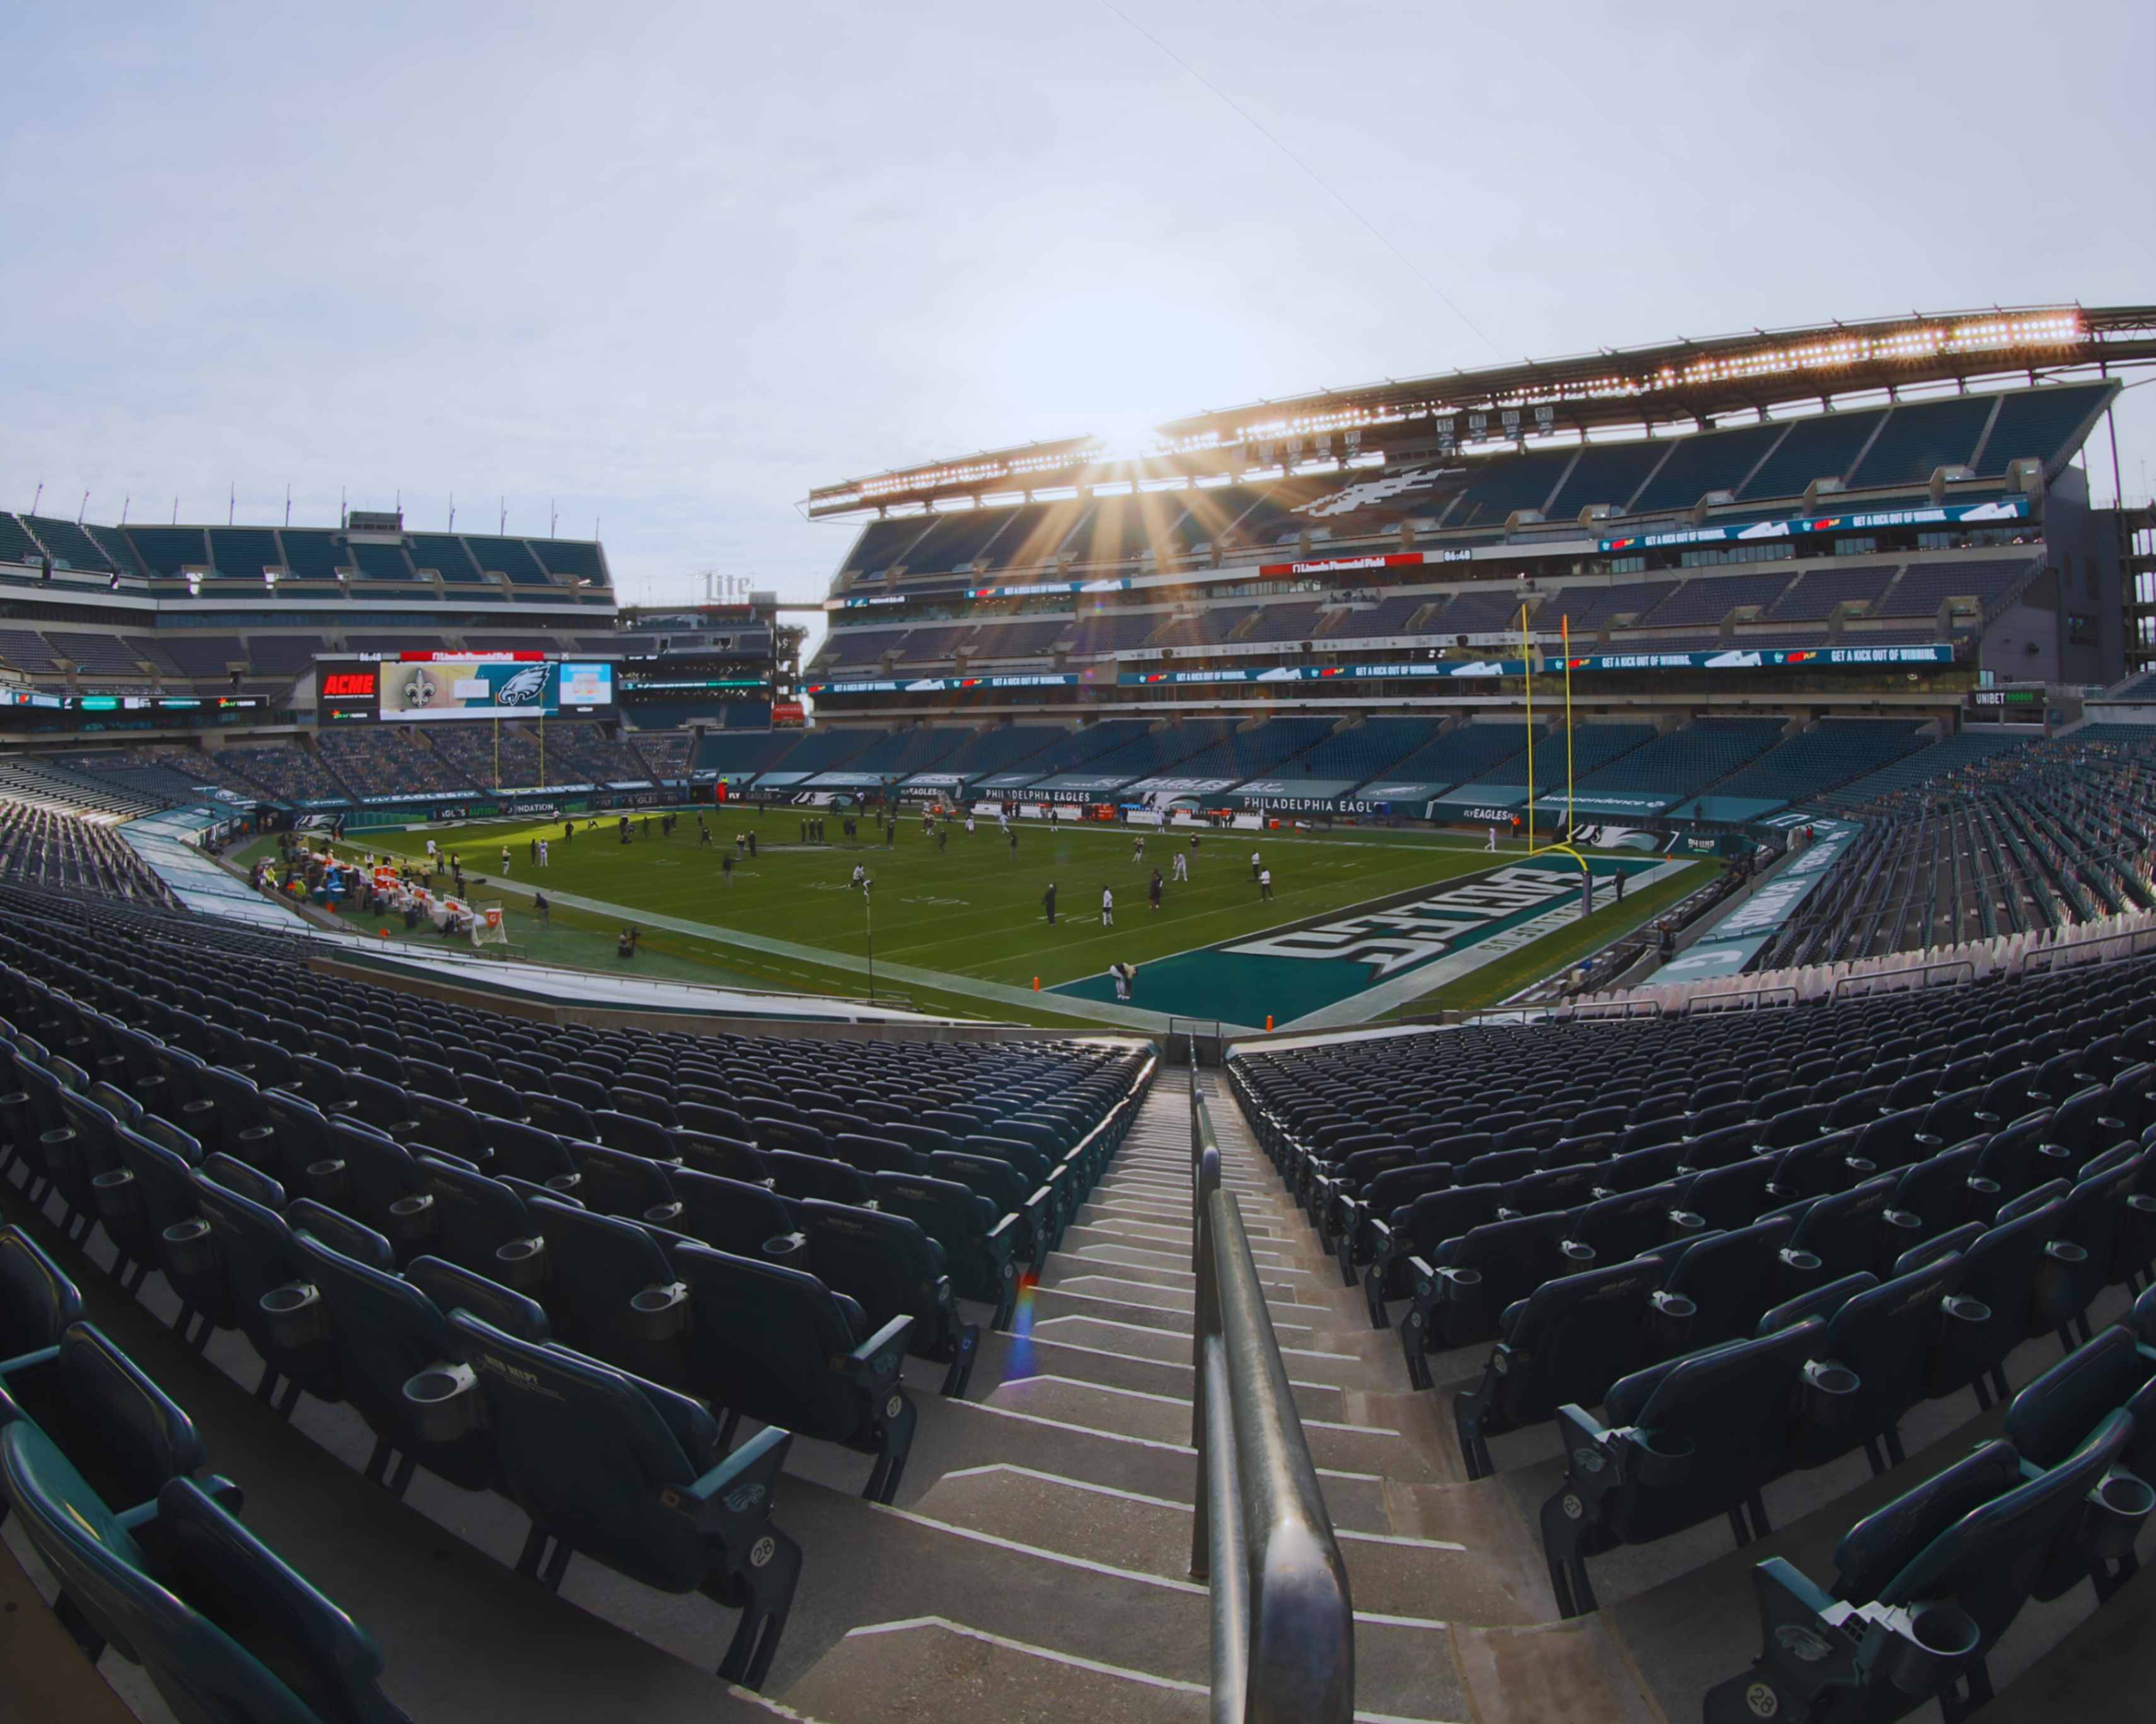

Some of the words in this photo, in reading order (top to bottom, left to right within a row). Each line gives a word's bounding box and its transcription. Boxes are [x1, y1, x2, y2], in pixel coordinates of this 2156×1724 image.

[1853, 516, 1865, 526] GET
[1873, 514, 1889, 524] KICK
[1889, 513, 1903, 524] OUT
[1903, 512, 1913, 523] OF
[1645, 536, 1655, 546] GET
[1662, 534, 1676, 545] KICK
[1676, 533, 1688, 543] OUT
[1689, 531, 1696, 541] OF
[1444, 550, 1470, 562] 86:48
[1831, 651, 1846, 661] GET
[1846, 651, 1853, 661] A
[1853, 650, 1872, 661] KICK
[1872, 650, 1888, 661] OUT
[1889, 649, 1899, 661] OF
[1900, 648, 1937, 660] WINNING.
[1602, 657, 1614, 667] GET
[1621, 657, 1635, 667] KICK
[1636, 657, 1650, 666] OUT
[1650, 656, 1659, 666] OF
[1176, 673, 1186, 681] GET
[1191, 673, 1203, 681] KICK
[1203, 672, 1214, 681] OUT
[1214, 672, 1221, 680] OF
[1356, 667, 1367, 676] GET
[1373, 666, 1387, 675] KICK
[1388, 666, 1400, 674] OUT
[1401, 666, 1409, 674] OF
[323, 675, 374, 695] ACME
[1976, 693, 2005, 704] UNIBET
[1054, 792, 1090, 802] EAGLES
[1541, 795, 1645, 806] Independence
[1244, 797, 1333, 811] PHILADELPHIA
[1340, 801, 1381, 813] EAGL
[1473, 808, 1507, 820] EAGLES
[1477, 939, 1521, 952] US
[753, 1539, 774, 1563] 28
[1749, 1687, 1773, 1714] 28
